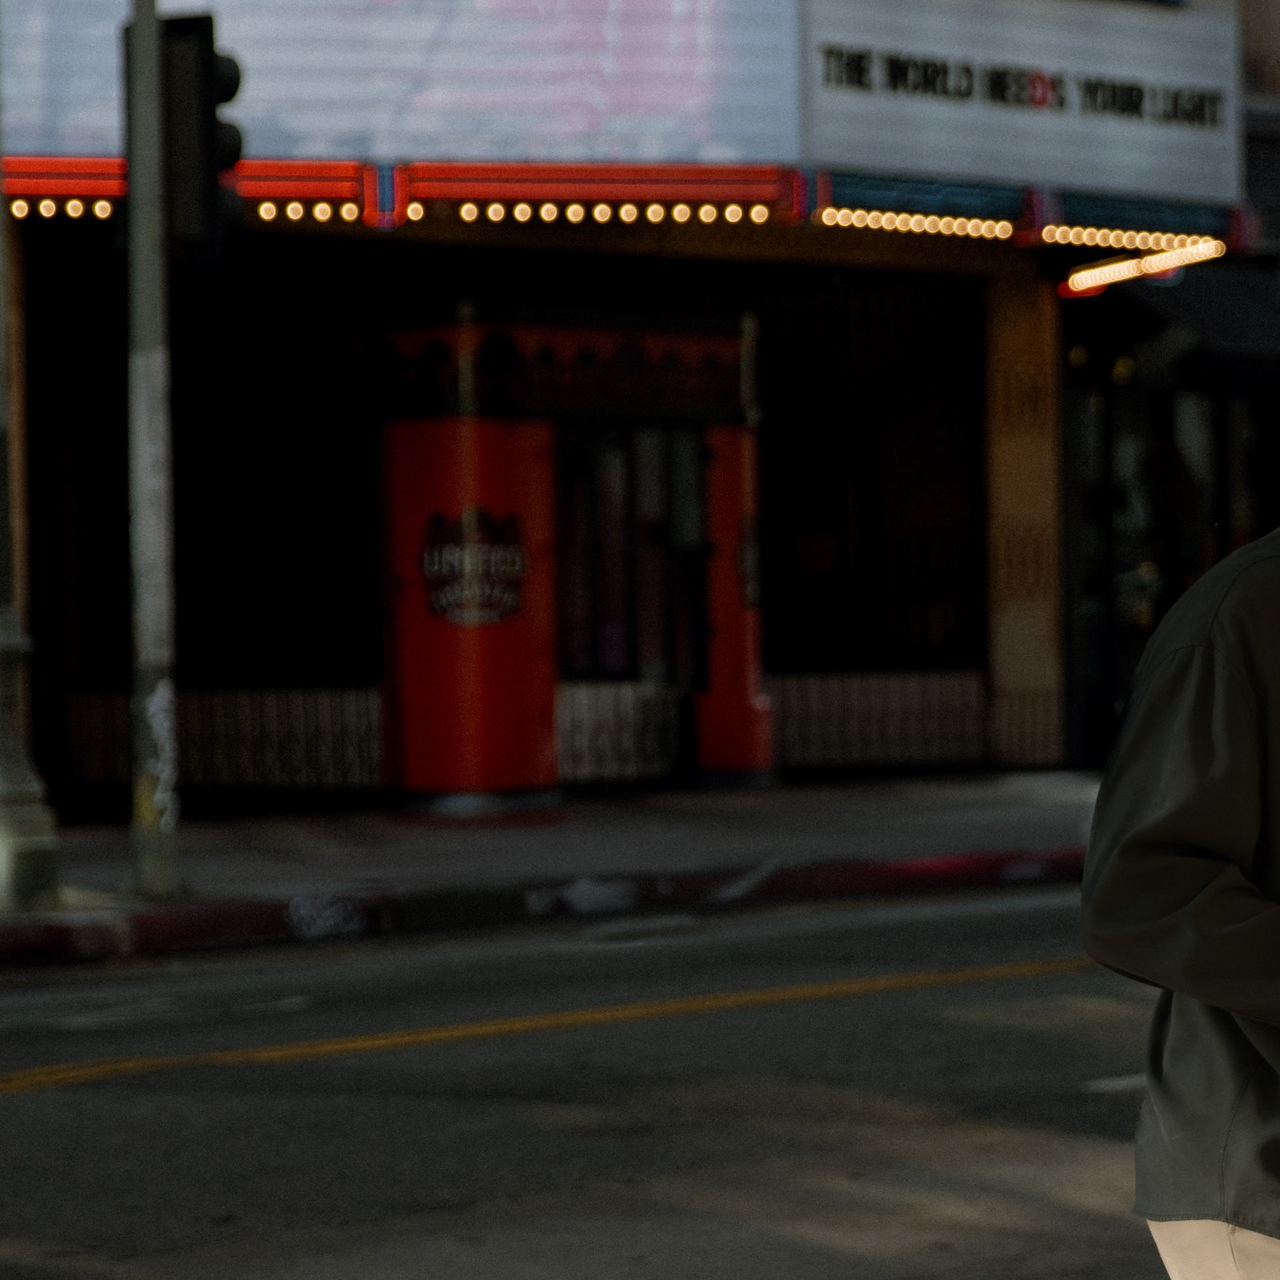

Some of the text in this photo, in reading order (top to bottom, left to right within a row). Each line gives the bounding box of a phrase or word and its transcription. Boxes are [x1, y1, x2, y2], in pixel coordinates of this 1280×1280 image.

[821, 42, 1223, 127] THE WORLD NEEDS YOUR LIGHT
